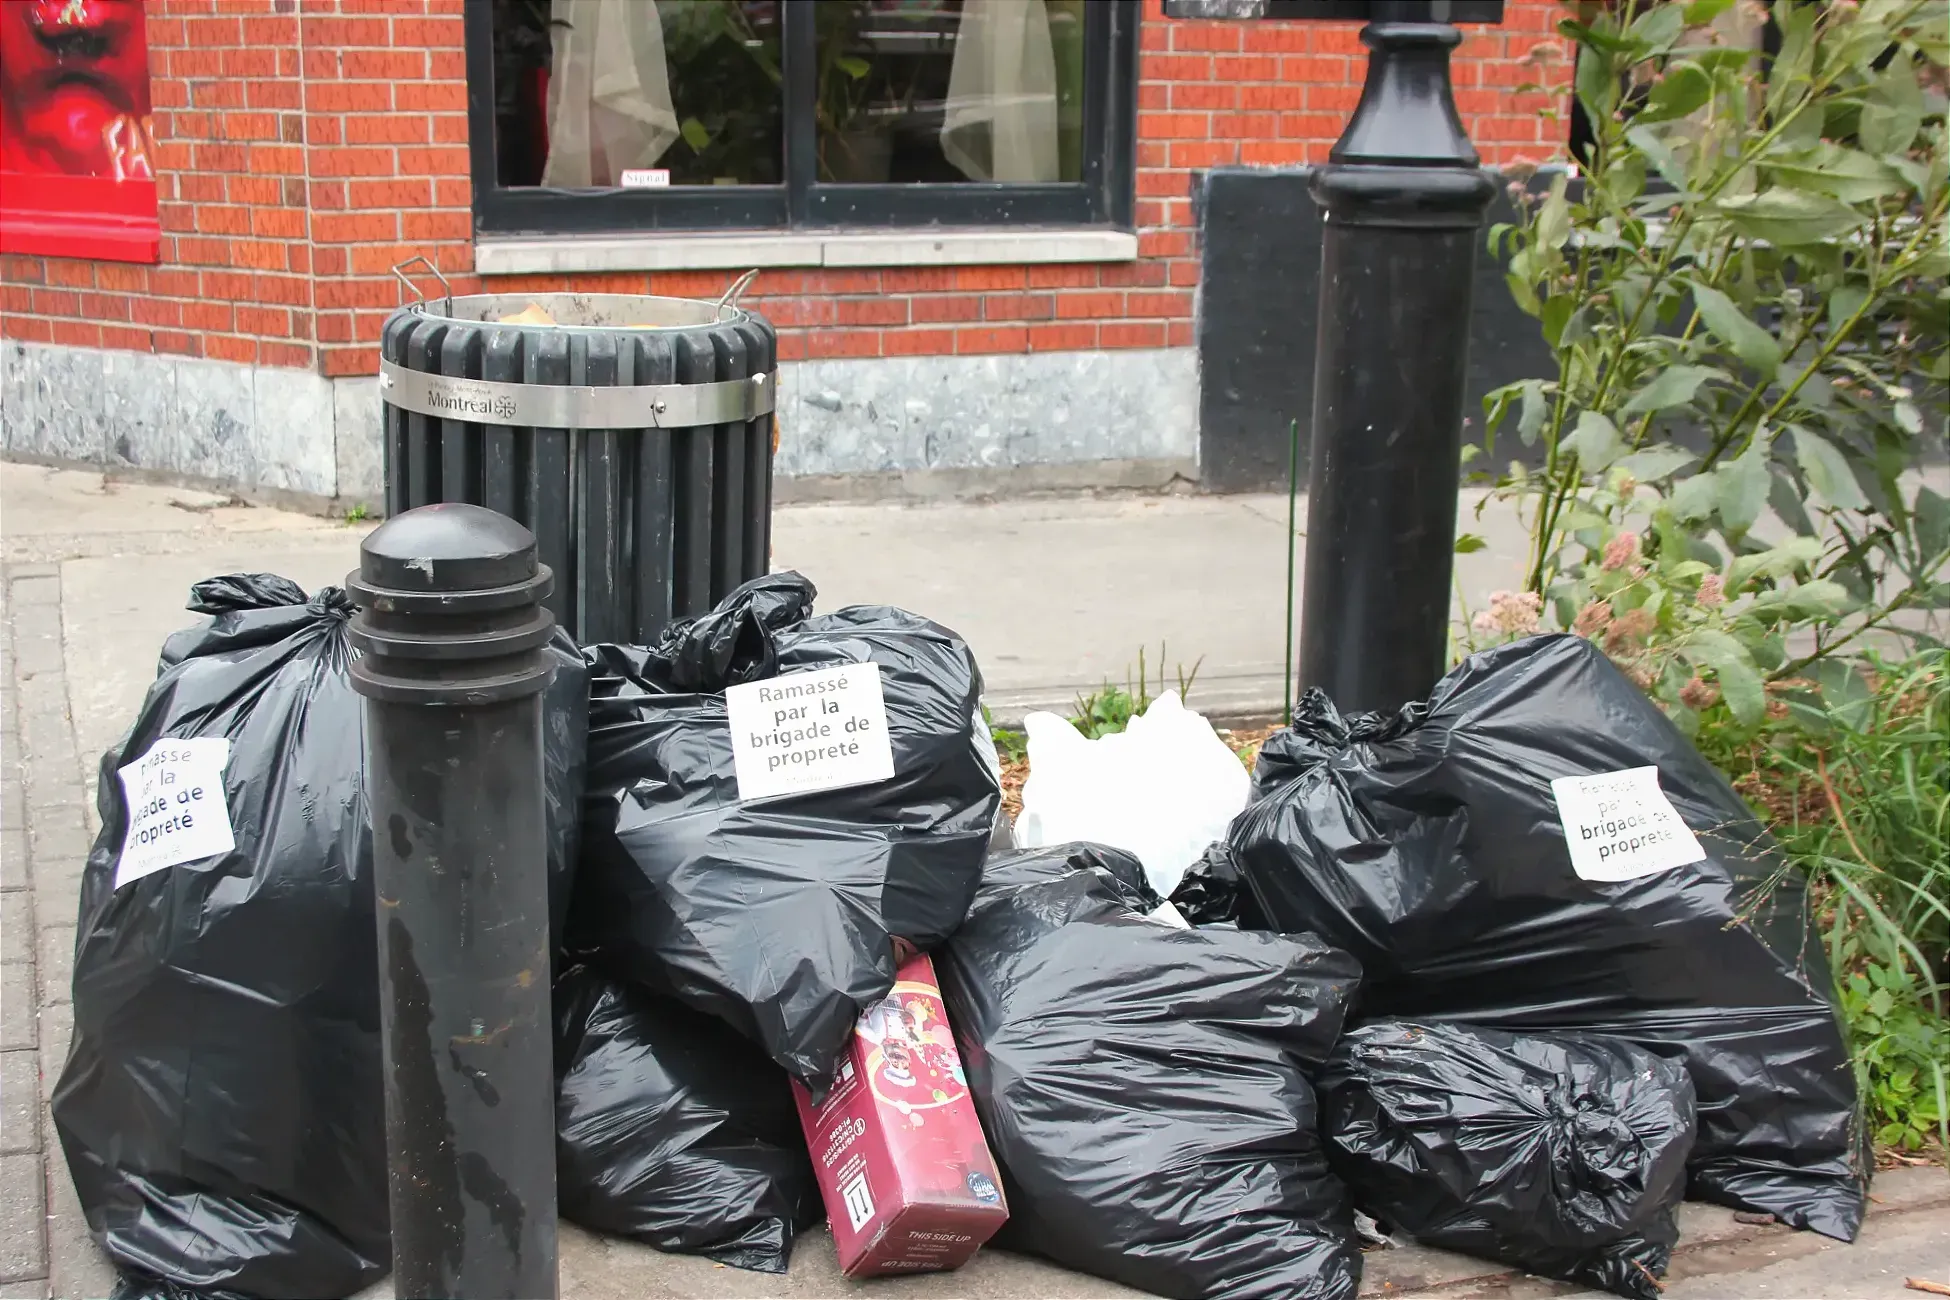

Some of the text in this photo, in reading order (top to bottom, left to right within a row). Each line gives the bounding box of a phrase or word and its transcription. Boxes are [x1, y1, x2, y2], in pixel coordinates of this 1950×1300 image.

[759, 673, 848, 703] Ramassé
[774, 698, 840, 727] par la
[750, 716, 870, 748] brigade de
[768, 738, 859, 772] propreté
[160, 768, 176, 786] la
[177, 786, 203, 804] de
[908, 1231, 932, 1240] THIS
[931, 1233, 955, 1242] SIDE
